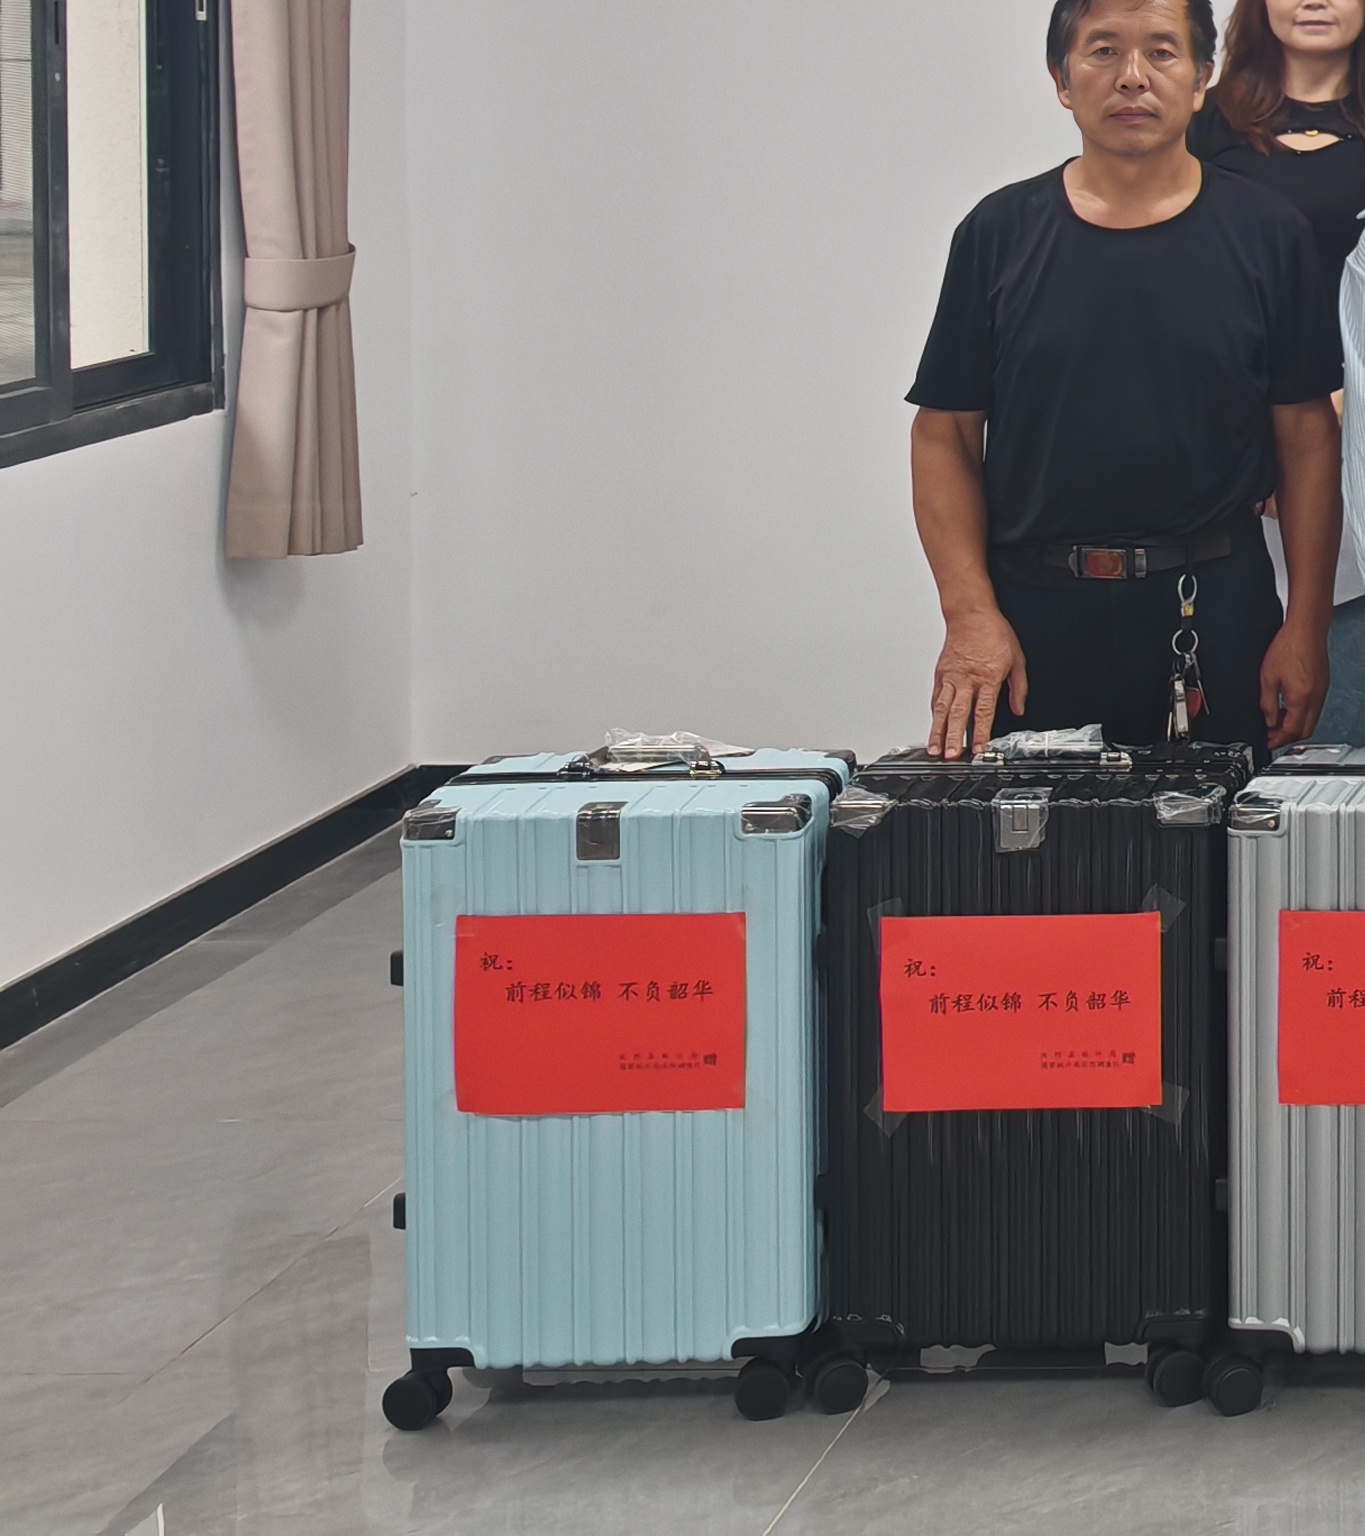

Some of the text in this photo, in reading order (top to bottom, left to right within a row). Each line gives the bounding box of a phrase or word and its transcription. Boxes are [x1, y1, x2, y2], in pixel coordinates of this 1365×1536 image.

[505, 979, 714, 1004] 前程似锦 不负韶华
[928, 989, 1131, 1016] 前程似锦 不负韶华
